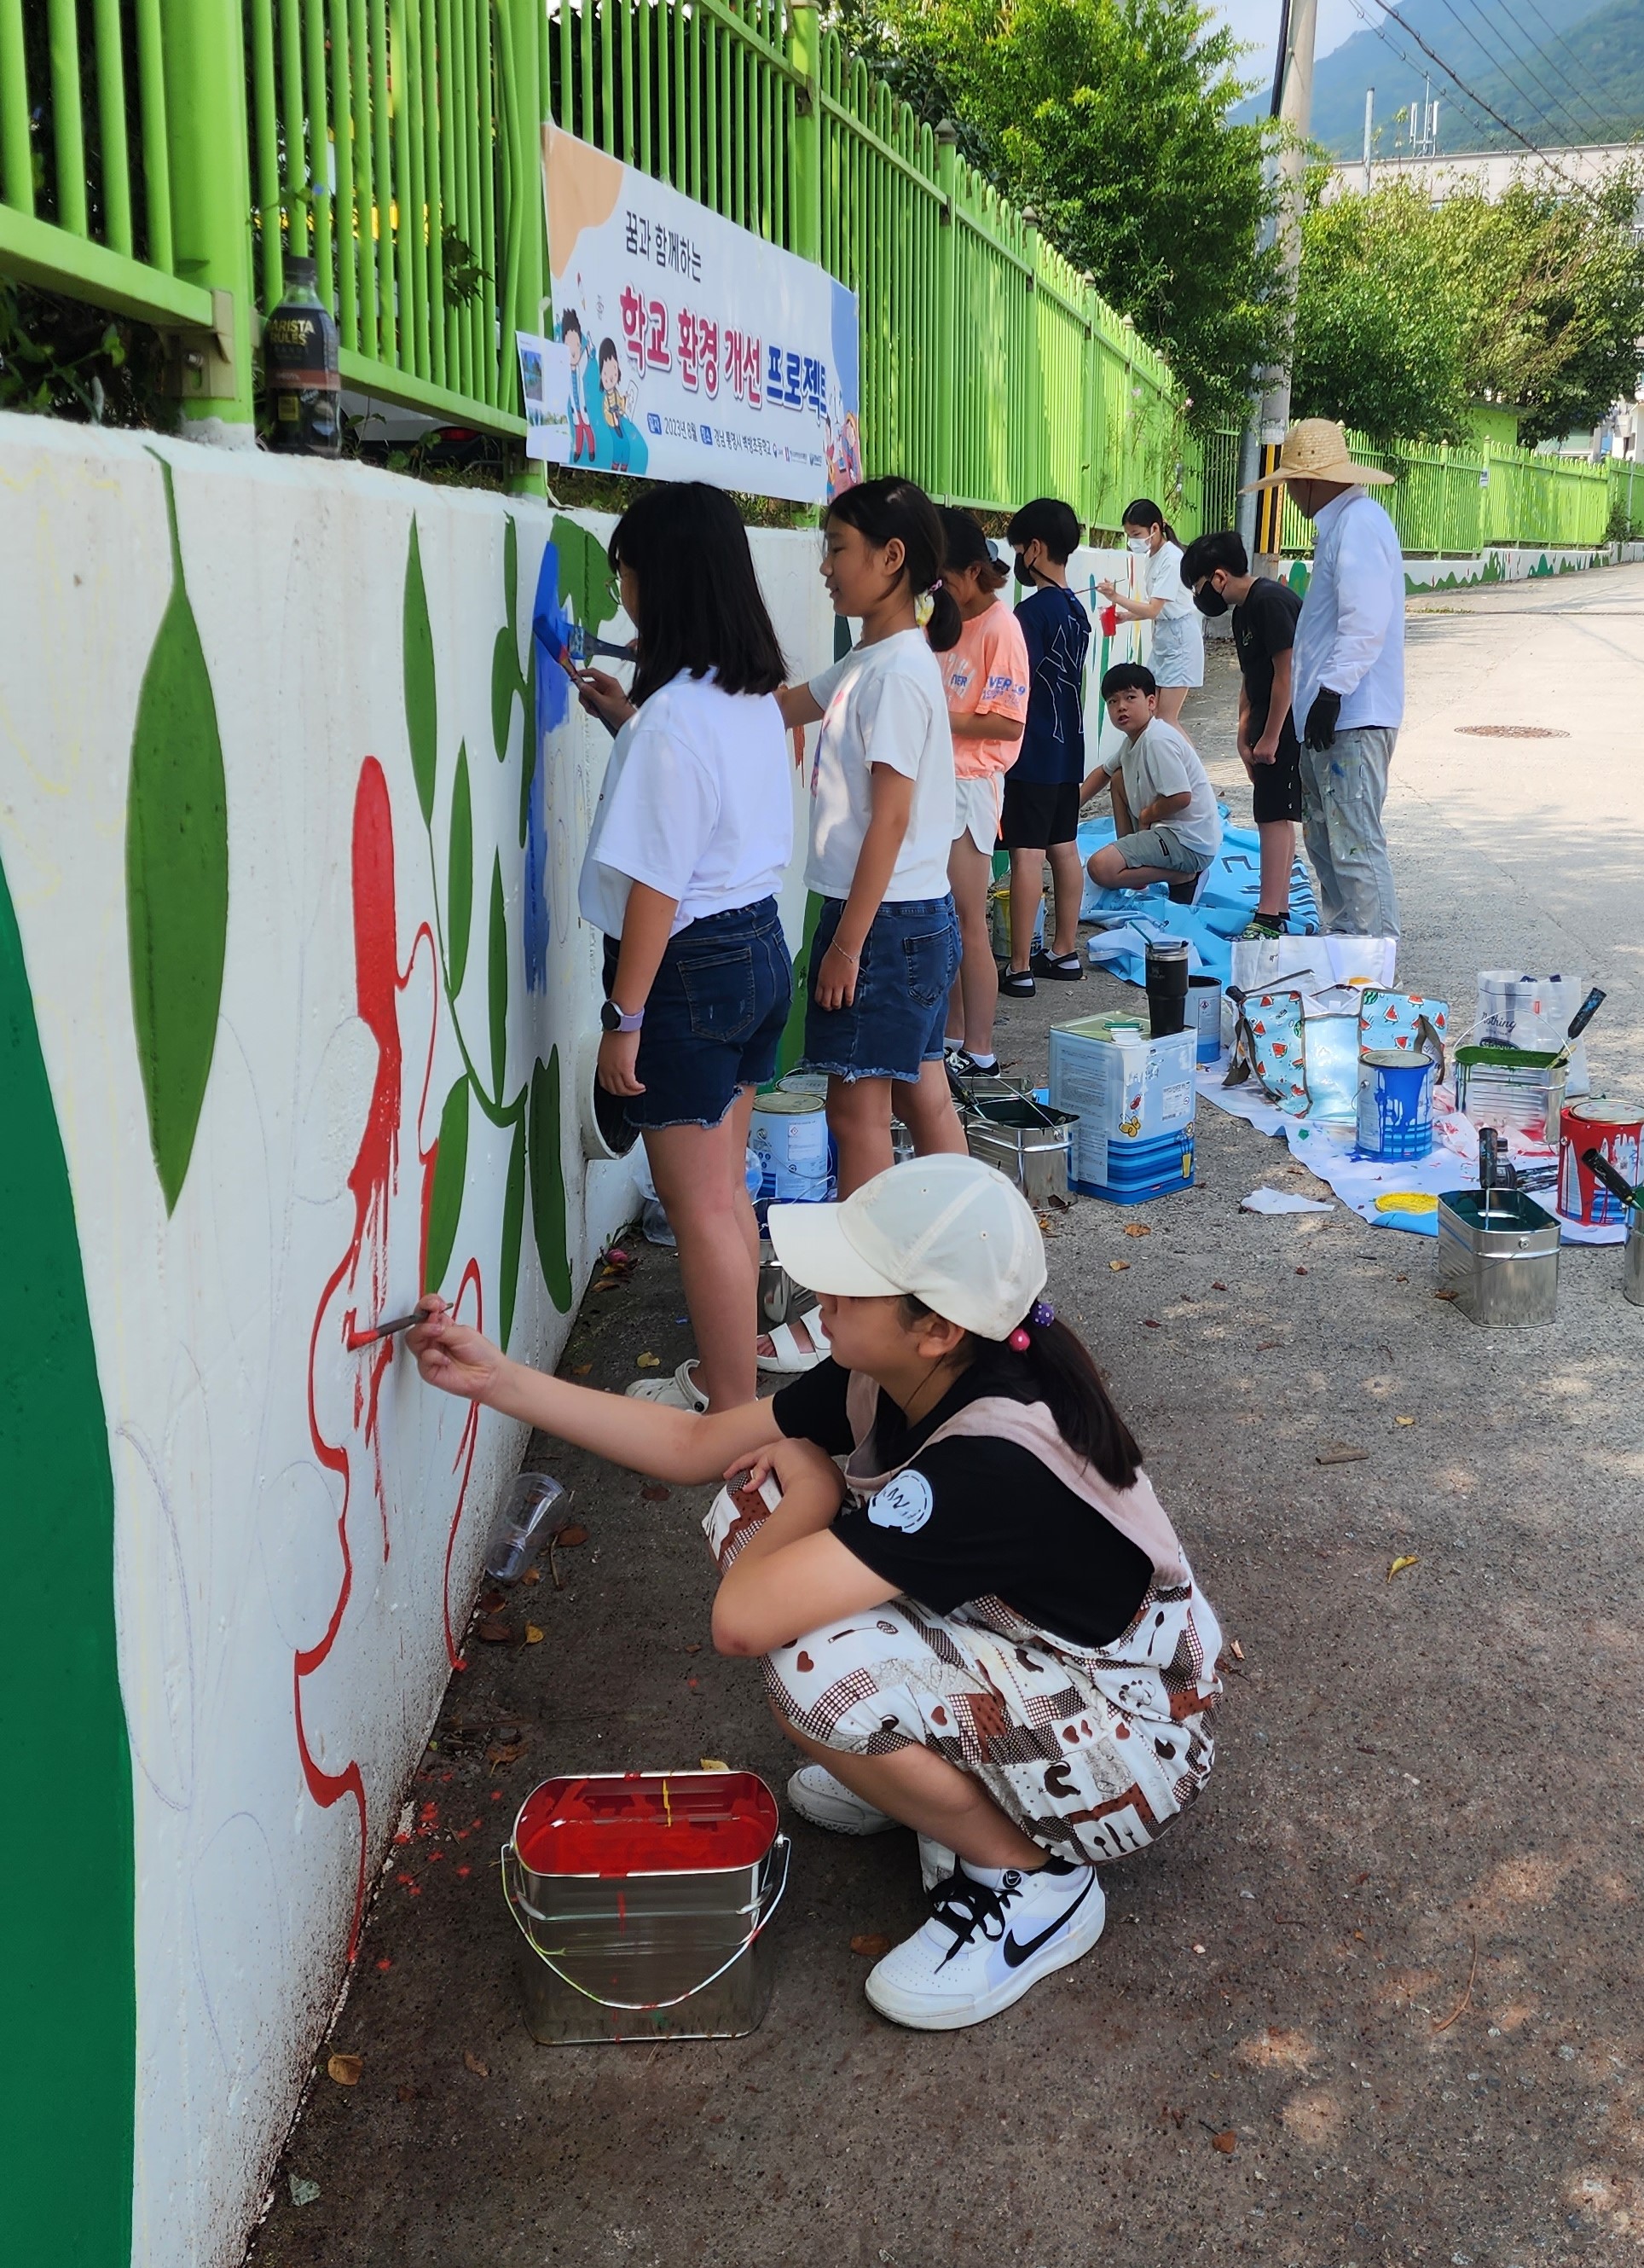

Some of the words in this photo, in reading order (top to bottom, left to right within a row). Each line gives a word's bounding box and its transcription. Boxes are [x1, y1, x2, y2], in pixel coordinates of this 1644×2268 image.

[626, 210, 651, 261] 꿈과
[655, 223, 702, 283] 함께하는
[620, 286, 670, 373] 학교
[678, 308, 717, 393] 환경
[725, 329, 760, 403] 개선
[767, 345, 827, 420] 프로젝트
[664, 417, 687, 439] 2023년
[687, 422, 698, 442] 8월
[714, 428, 726, 448] 경남
[726, 431, 743, 451] 통영시
